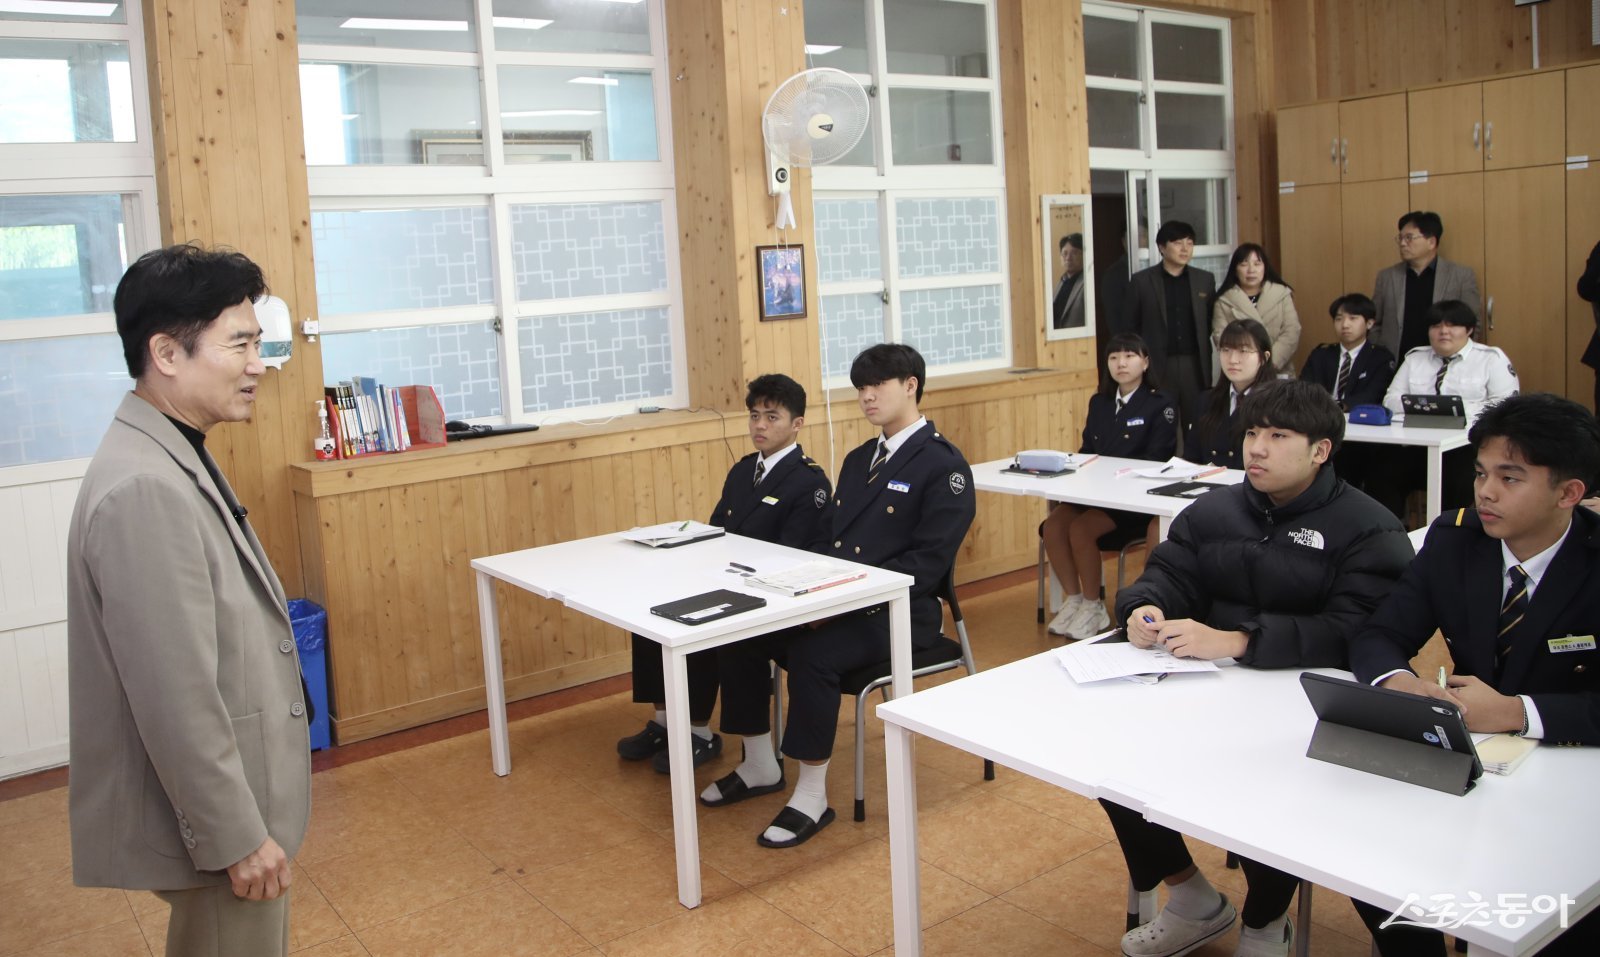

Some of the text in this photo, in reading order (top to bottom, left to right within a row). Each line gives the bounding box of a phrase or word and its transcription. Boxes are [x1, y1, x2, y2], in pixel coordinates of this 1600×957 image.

[1288, 531, 1313, 541] NORTH
[1301, 528, 1314, 536] THE
[1294, 537, 1313, 547] FACE
